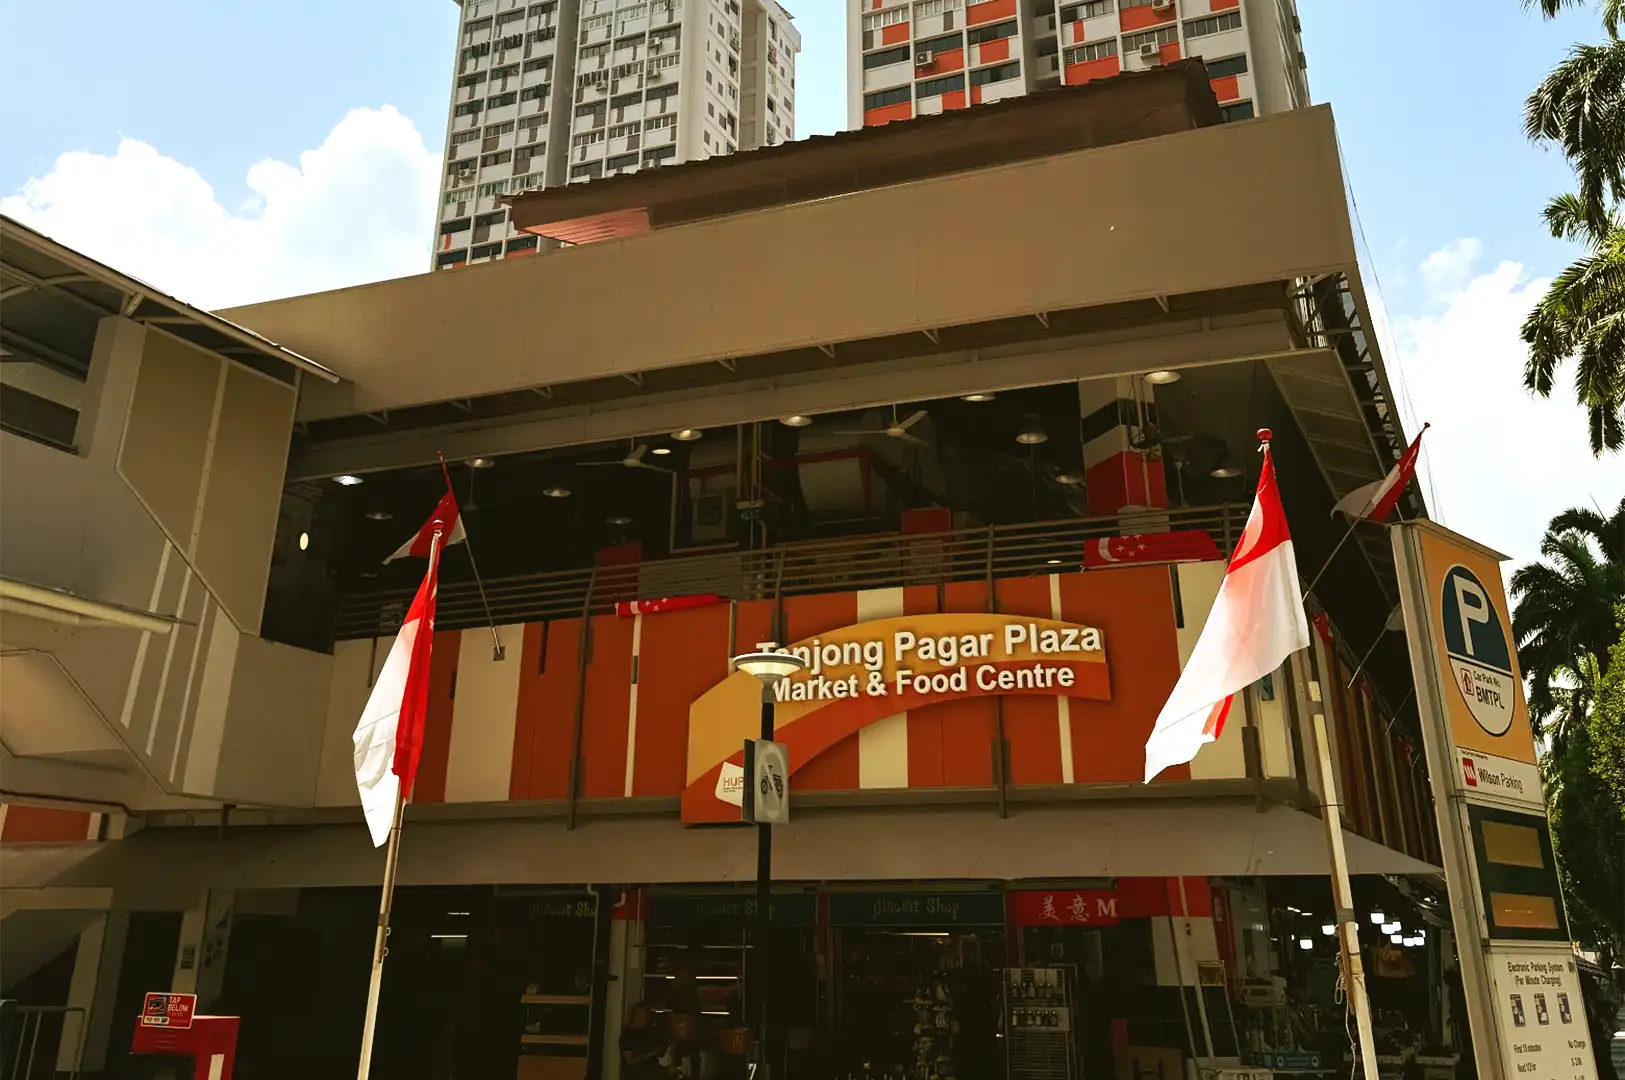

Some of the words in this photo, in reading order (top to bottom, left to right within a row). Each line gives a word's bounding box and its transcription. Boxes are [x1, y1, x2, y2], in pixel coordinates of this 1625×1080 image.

[1453, 573, 1489, 656] P
[756, 639, 884, 675] Tnjong
[894, 631, 994, 666] Pagar
[1004, 623, 1101, 655] Plaza
[773, 673, 859, 702] Market
[866, 671, 888, 696] &
[896, 666, 967, 695] Food
[976, 663, 1075, 691] Centre
[1476, 685, 1505, 709] BMTPL
[1477, 767, 1501, 786] Wilson
[1500, 772, 1524, 794] Parking
[576, 901, 598, 917] Sho
[926, 896, 959, 920] Shop
[1507, 960, 1530, 973] Electronic
[1530, 961, 1548, 975] Parking
[1547, 961, 1564, 975] System
[167, 1003, 189, 1012] BELOW
[169, 996, 181, 1004] TAP
